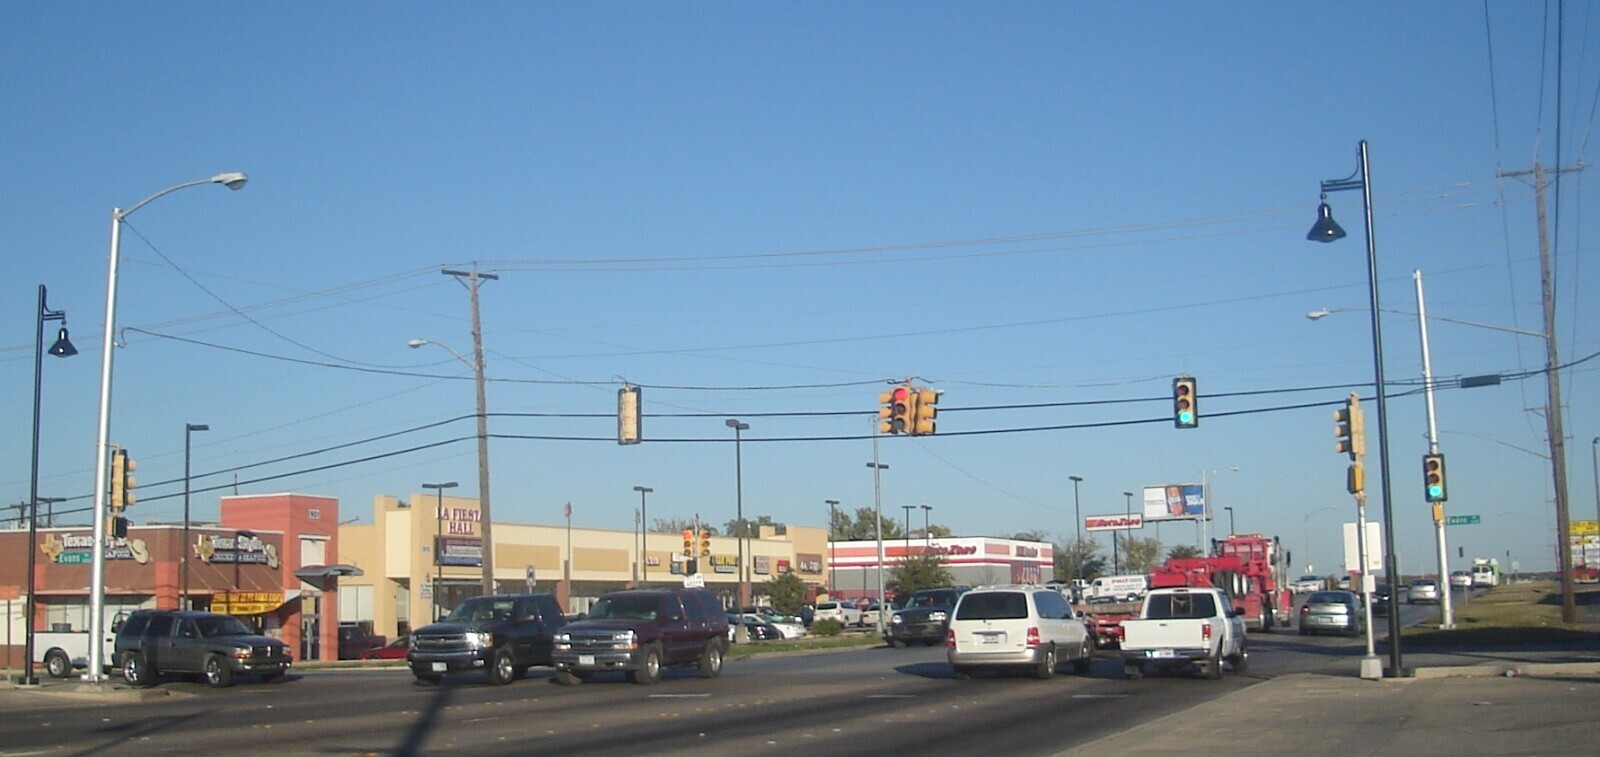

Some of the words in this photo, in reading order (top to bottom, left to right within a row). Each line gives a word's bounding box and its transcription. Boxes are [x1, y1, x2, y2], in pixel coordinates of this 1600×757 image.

[451, 508, 481, 522] FIEST
[1096, 517, 1140, 527] AutoZone
[448, 522, 474, 535] HALL
[60, 552, 81, 563] Evans
